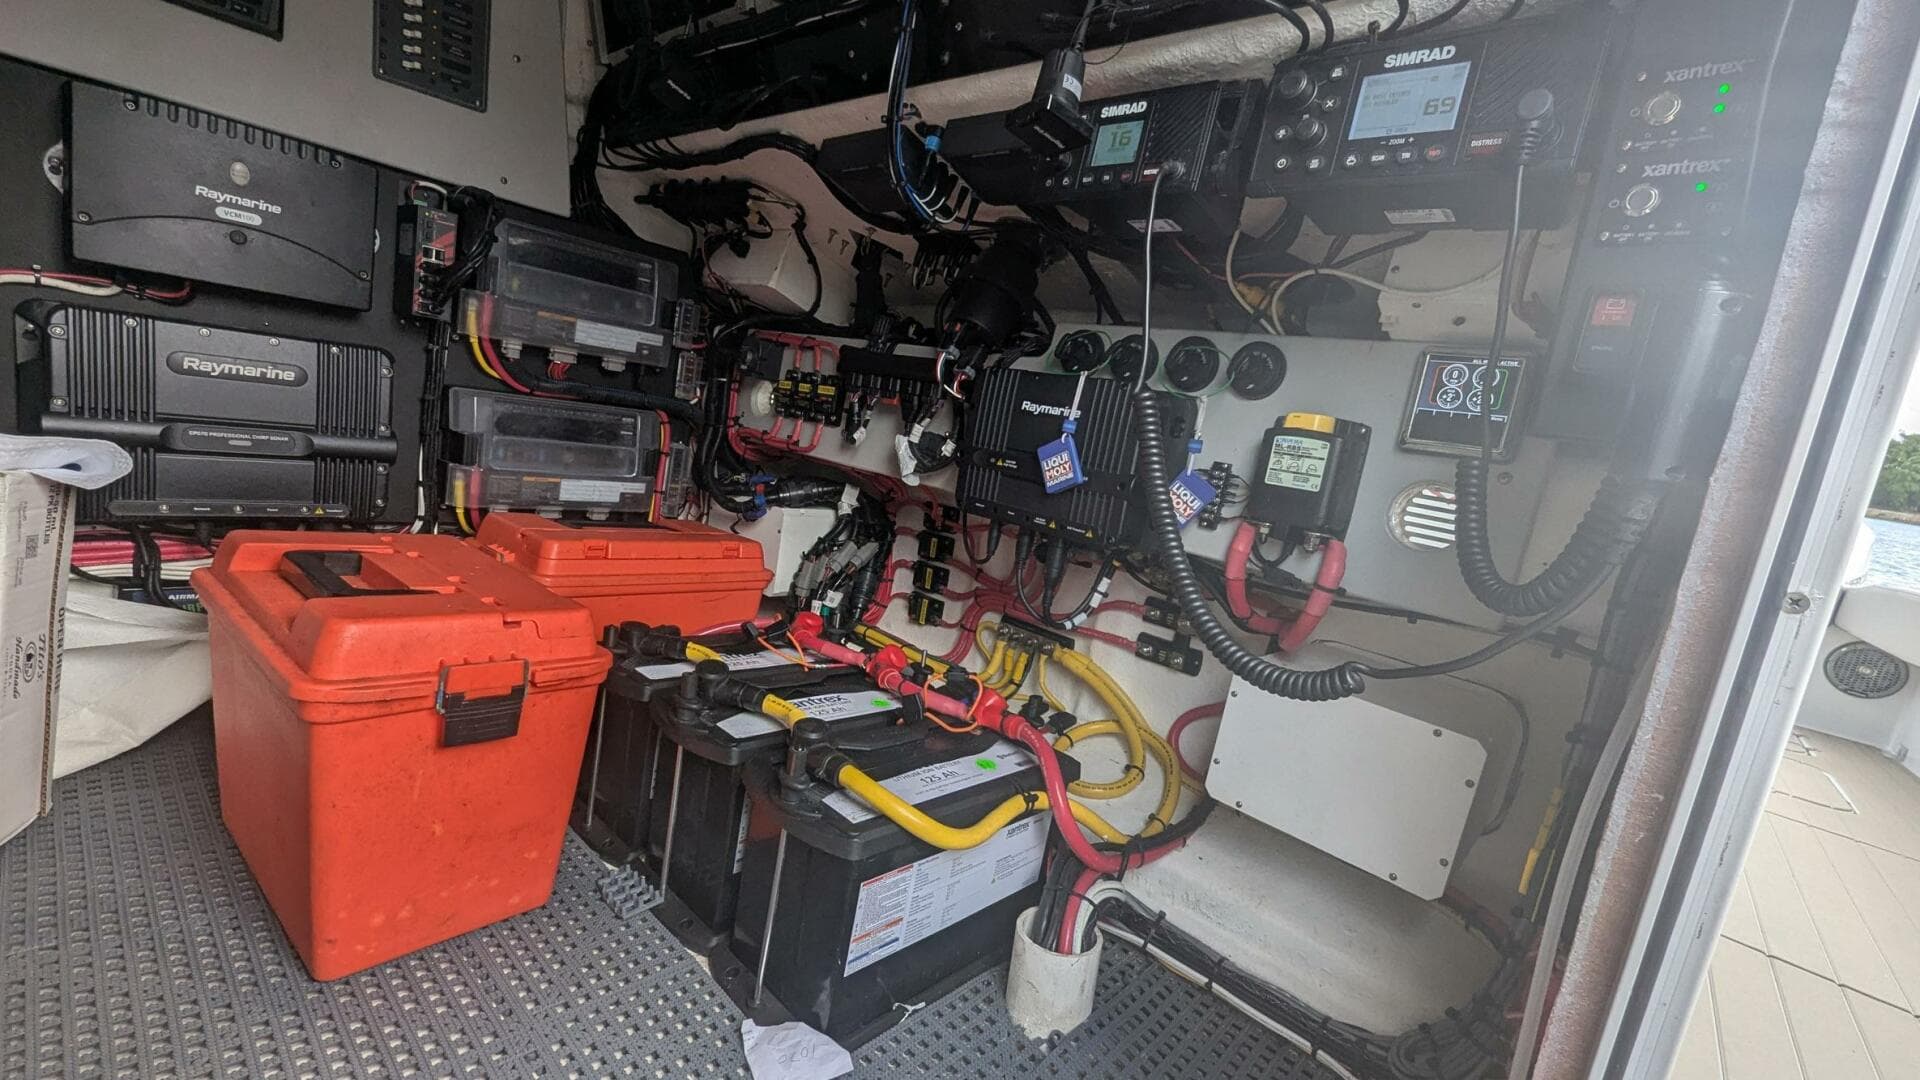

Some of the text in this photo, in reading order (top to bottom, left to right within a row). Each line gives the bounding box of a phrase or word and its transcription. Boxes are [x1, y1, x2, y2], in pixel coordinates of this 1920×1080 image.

[1384, 45, 1456, 68] SIMRAD
[1664, 62, 1743, 83] xantrex
[1101, 101, 1148, 118] SIMRAD
[1423, 96, 1456, 115] 69
[1110, 130, 1132, 148] 16
[1471, 138, 1503, 147] DISTRESS
[1642, 159, 1721, 177] xantrex
[195, 185, 282, 214] Raymarine
[223, 209, 256, 223] VCM100
[183, 357, 296, 381] Raymarine
[1043, 452, 1070, 470] LIQUI
[1045, 462, 1071, 480] MOLY
[1172, 482, 1201, 510] LIQUI
[56, 607, 66, 649] OPEN
[37, 633, 47, 680] Tito's
[13, 636, 24, 700] Handmade
[791, 694, 845, 709] antrex
[919, 774, 942, 785] 125
[943, 769, 960, 780] Ah
